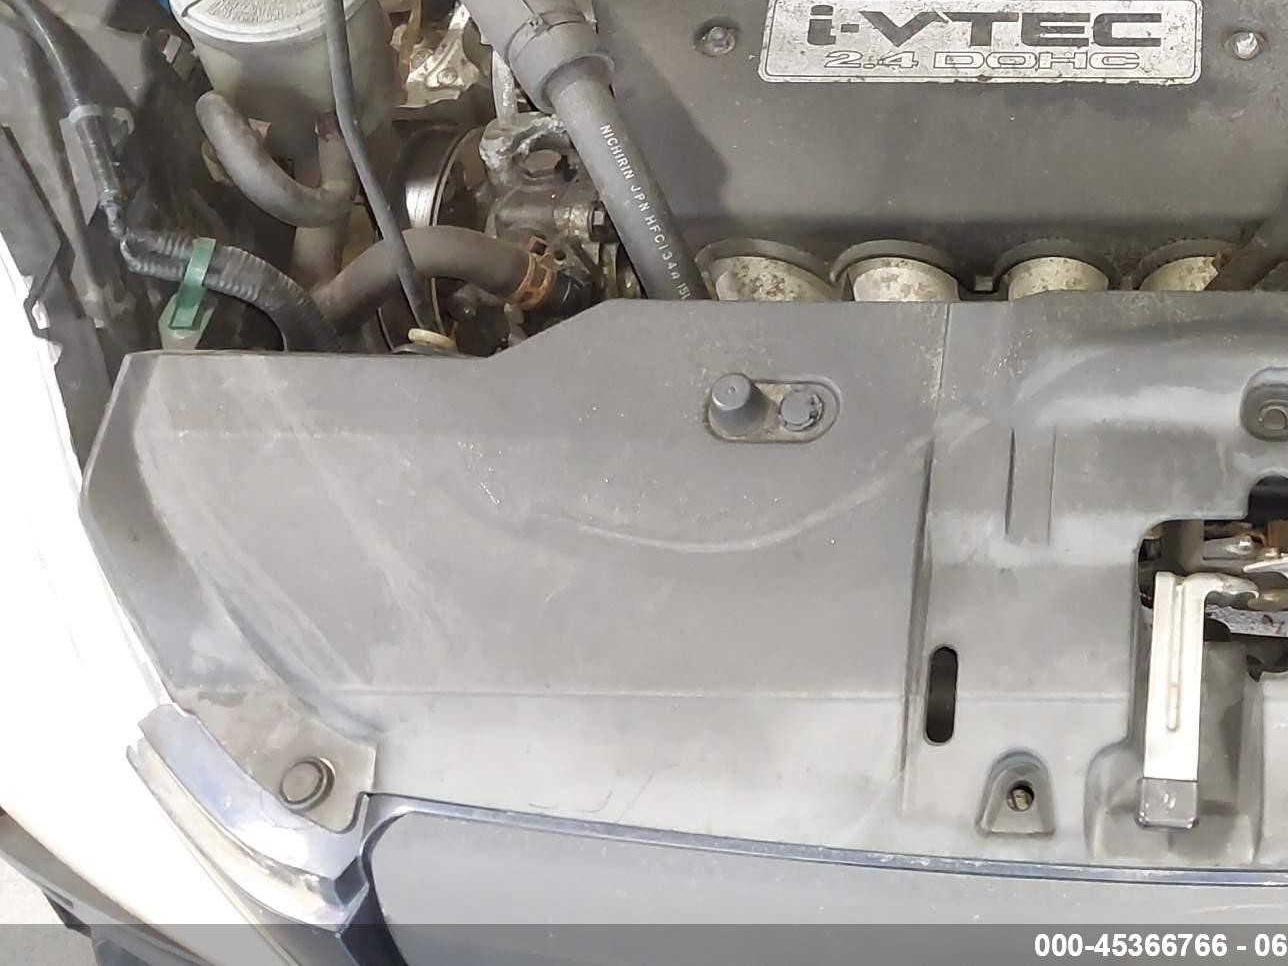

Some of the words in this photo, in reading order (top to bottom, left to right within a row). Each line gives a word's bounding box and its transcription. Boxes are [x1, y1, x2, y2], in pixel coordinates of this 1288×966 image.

[806, 4, 1163, 48] i-VTEC
[824, 50, 919, 70] 2.4
[933, 50, 1141, 70] DOHC
[600, 122, 635, 180] NICHIRIN
[630, 183, 651, 212] JPN
